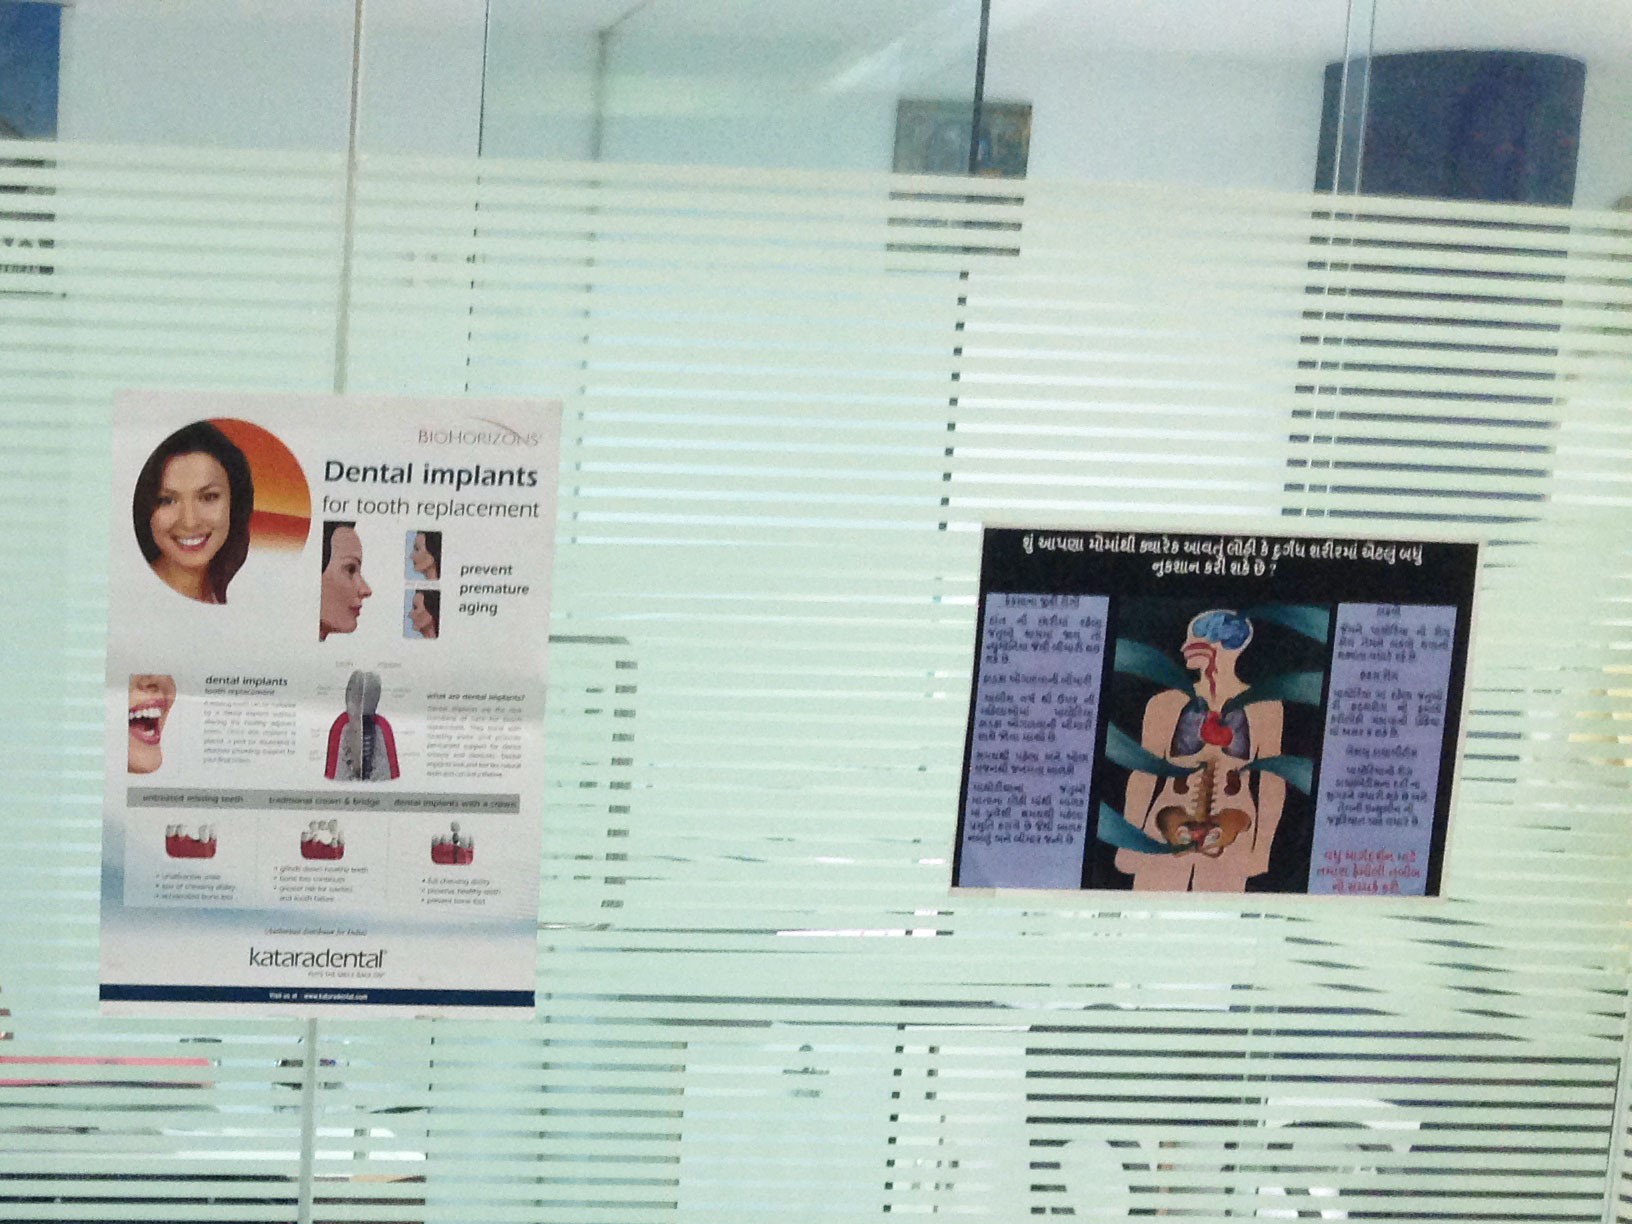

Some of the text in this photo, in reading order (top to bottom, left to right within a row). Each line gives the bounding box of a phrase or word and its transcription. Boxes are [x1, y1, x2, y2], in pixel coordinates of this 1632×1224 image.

[324, 460, 539, 492] Dental implants
[322, 495, 541, 521] for tooth replacement
[1038, 535, 1085, 553] આપણા
[460, 564, 514, 578] prevent
[459, 583, 531, 597] premature
[458, 601, 499, 617] aging
[204, 674, 289, 689] dental implants
[249, 946, 384, 969] kataradental
